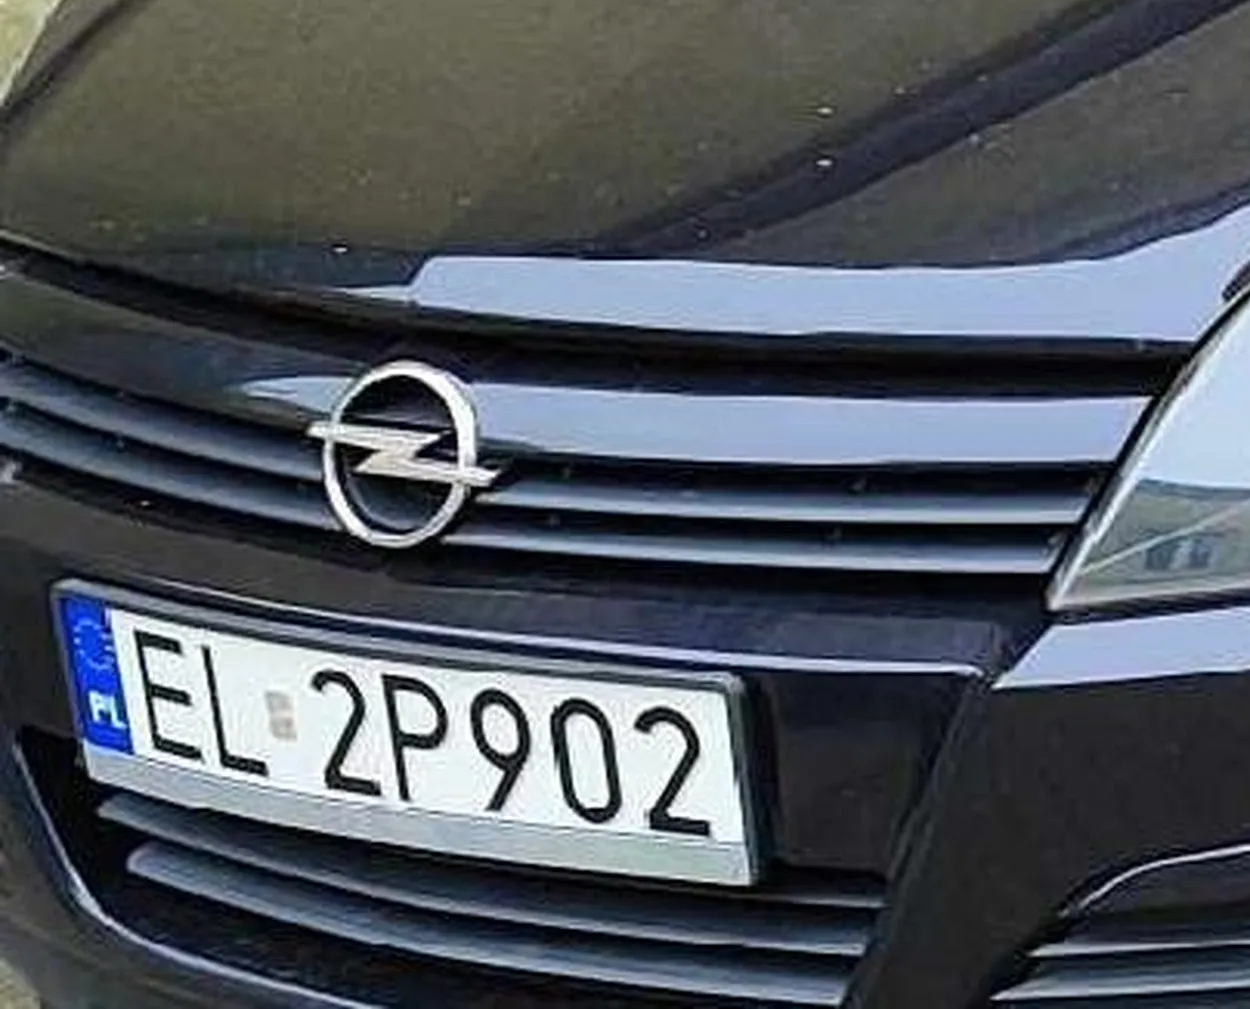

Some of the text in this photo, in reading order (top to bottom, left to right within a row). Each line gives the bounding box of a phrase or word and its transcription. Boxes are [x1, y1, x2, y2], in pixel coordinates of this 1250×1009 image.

[89, 691, 127, 729] PL
[134, 630, 710, 837] EL 2P902
